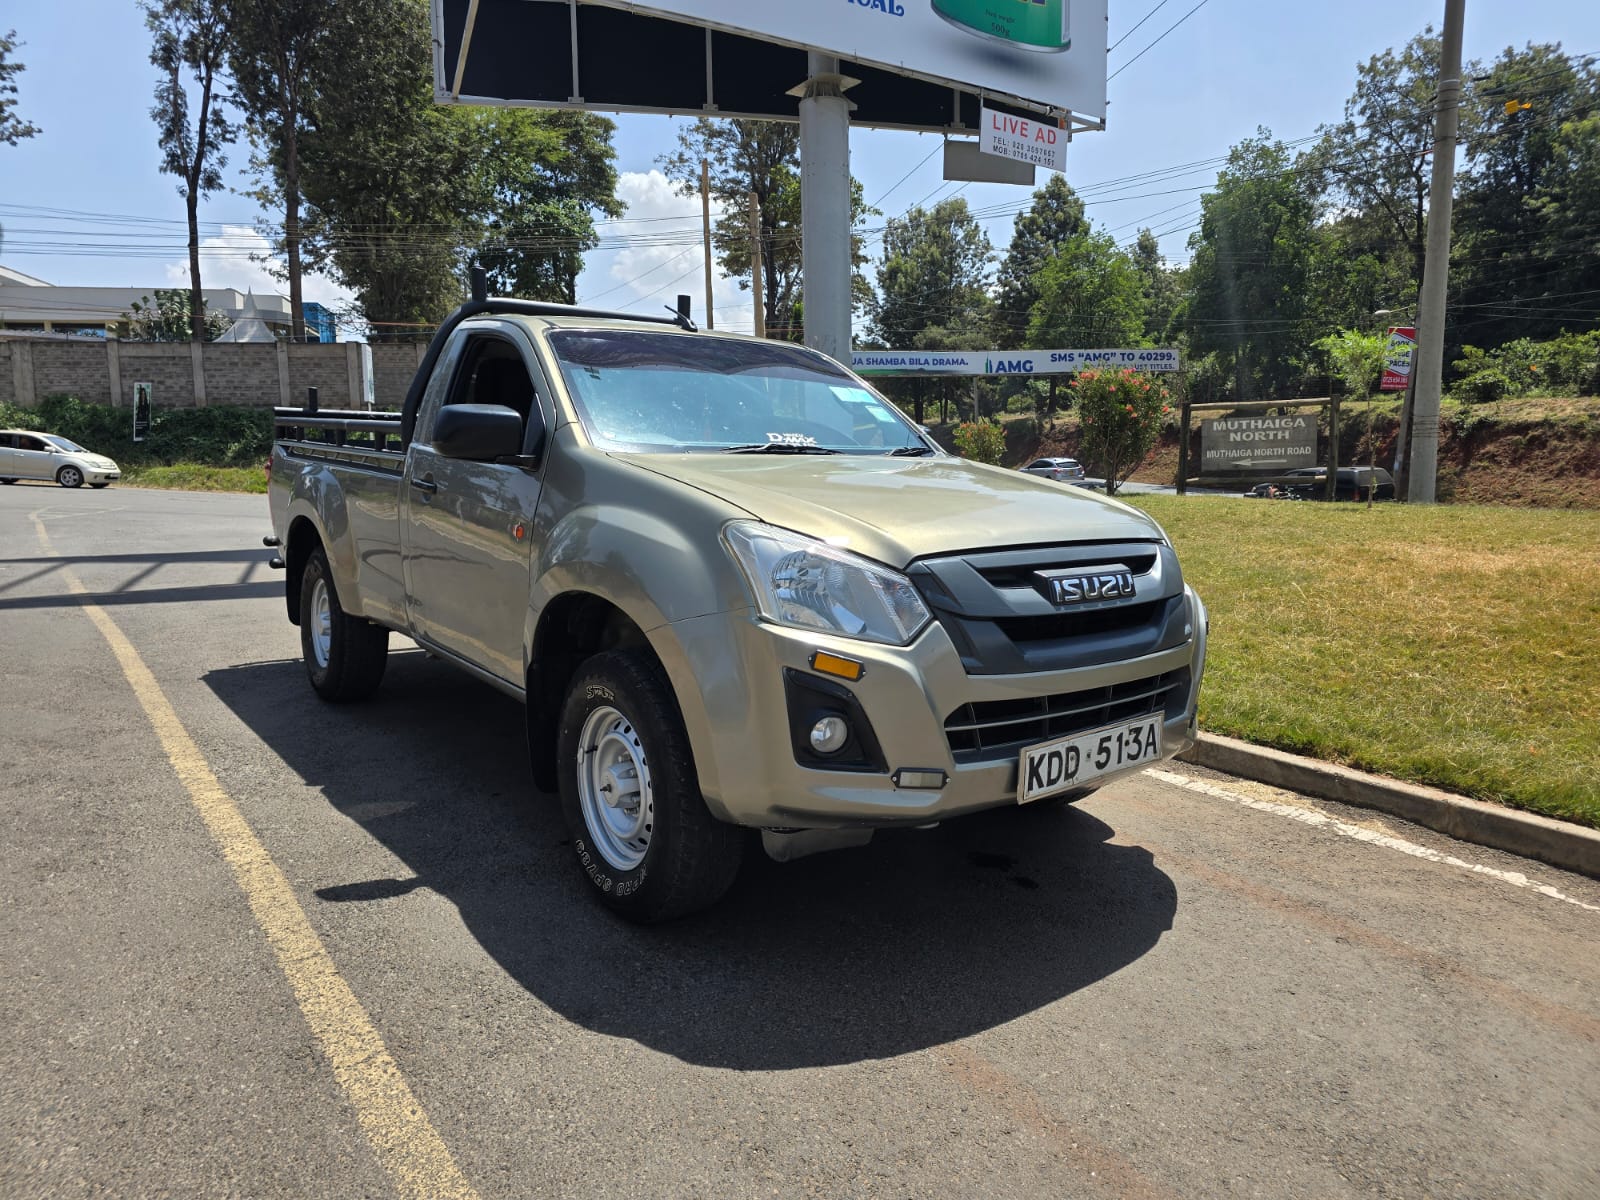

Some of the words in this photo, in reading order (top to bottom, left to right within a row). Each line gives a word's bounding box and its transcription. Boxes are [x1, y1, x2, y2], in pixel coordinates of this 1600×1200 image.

[992, 113, 1029, 138] LIVE
[1035, 127, 1057, 145] AD
[993, 136, 1010, 147] TEL:
[993, 145, 1011, 156] MOB:
[866, 357, 907, 366] SHAMBA
[909, 357, 929, 366] BILA
[932, 357, 969, 366] DRAMA.
[1050, 352, 1075, 363] SMS
[1120, 352, 1135, 361] TO
[1139, 352, 1176, 361] 40299.
[995, 359, 1034, 373] AMG
[1213, 418, 1306, 431] MUTHAIGA
[1229, 430, 1290, 442] NORTH
[1206, 448, 1252, 458] MUTHAIGA
[1254, 447, 1285, 456] NORTH
[1287, 446, 1312, 455] ROAD
[1053, 574, 1134, 602] ISUZU
[1027, 745, 1080, 792] KDD
[1095, 723, 1158, 770] 513A
